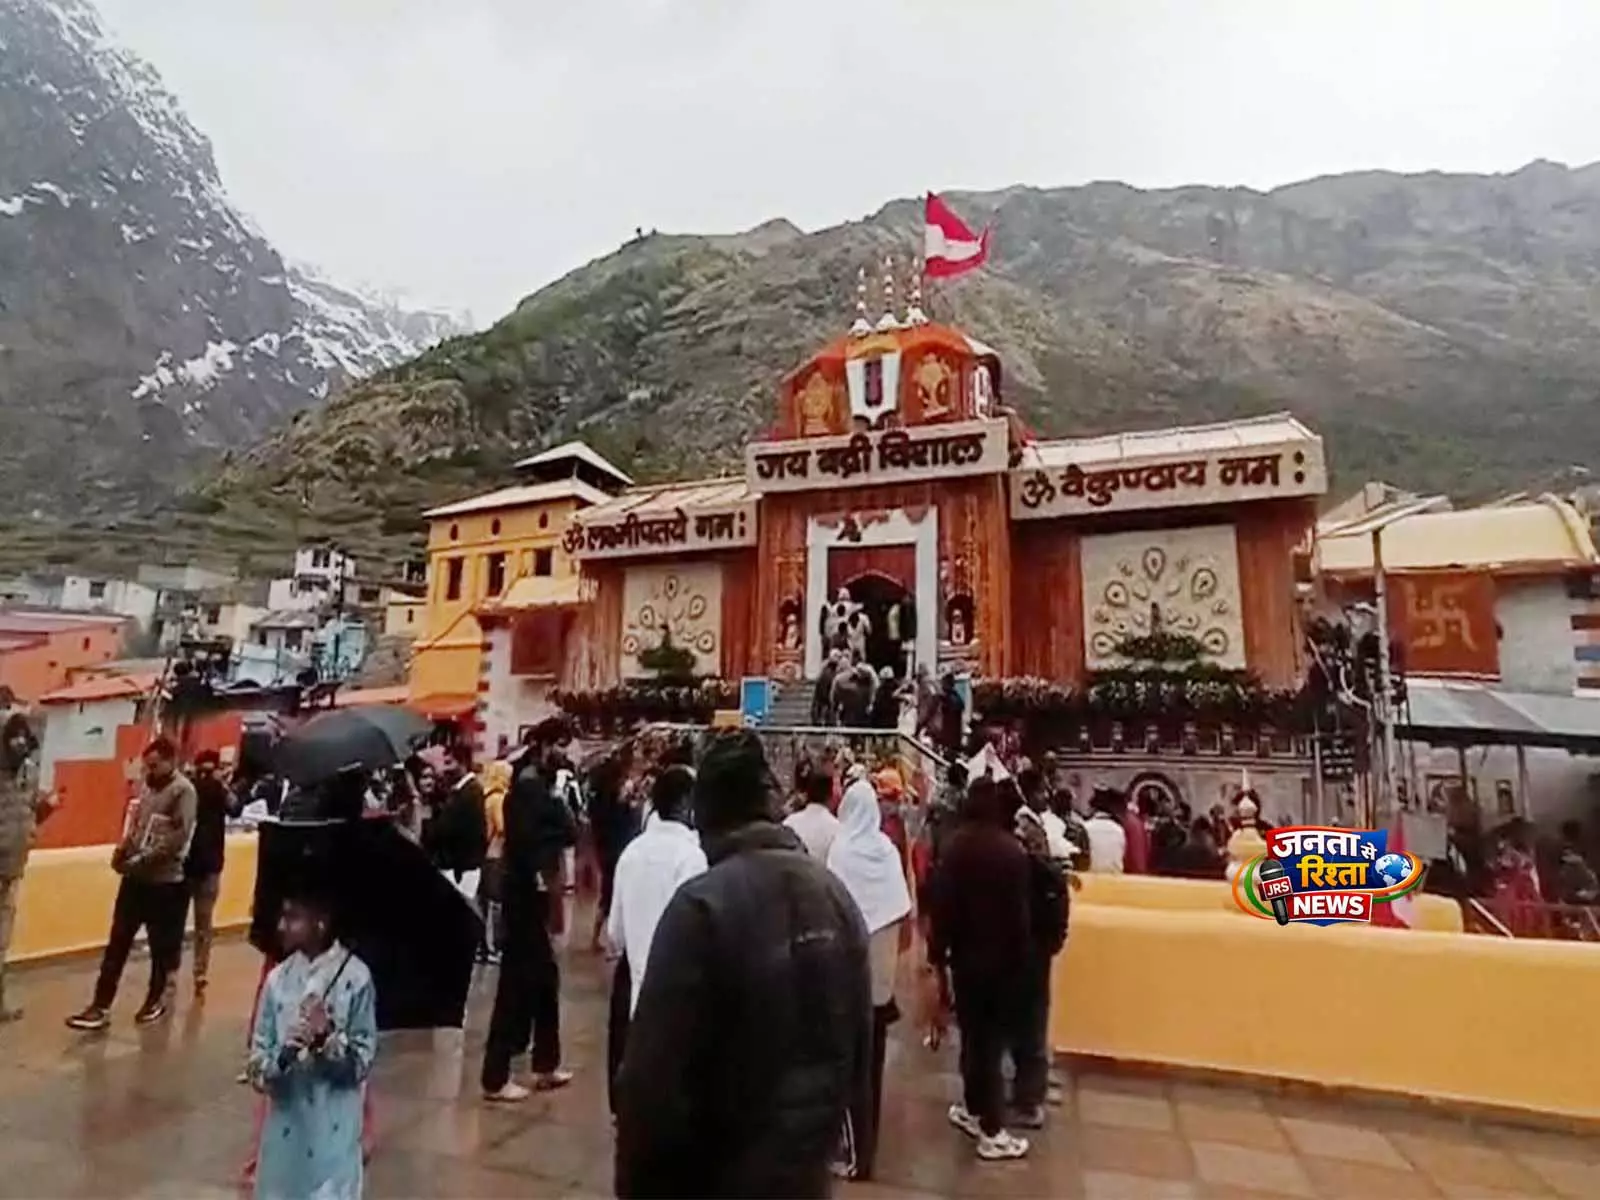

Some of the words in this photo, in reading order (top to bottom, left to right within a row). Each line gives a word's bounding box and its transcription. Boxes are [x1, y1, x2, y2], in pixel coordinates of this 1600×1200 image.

[755, 450, 809, 479] जय
[877, 431, 986, 470] विशाल
[1059, 463, 1207, 505] वैकुण्ठाय
